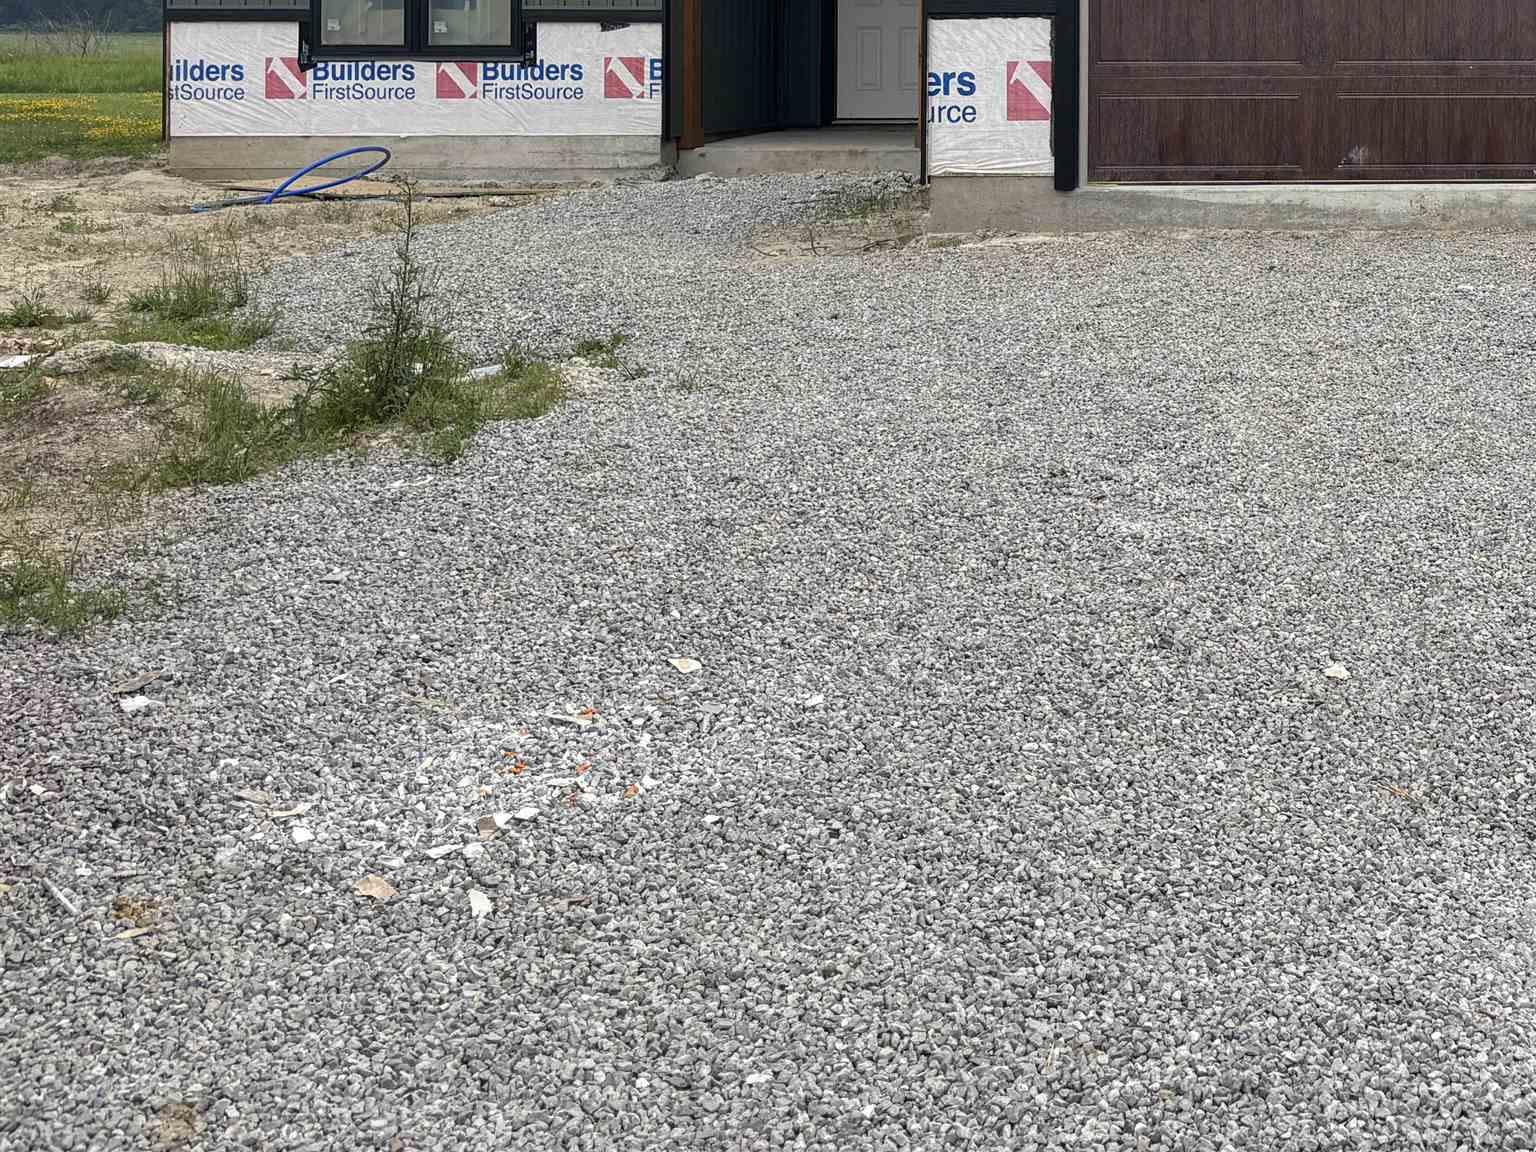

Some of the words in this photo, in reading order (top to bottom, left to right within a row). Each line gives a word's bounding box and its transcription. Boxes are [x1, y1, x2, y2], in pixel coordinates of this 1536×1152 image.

[313, 61, 415, 81] Builders
[312, 83, 416, 100] FirstSource
[482, 82, 584, 100] FirstSource
